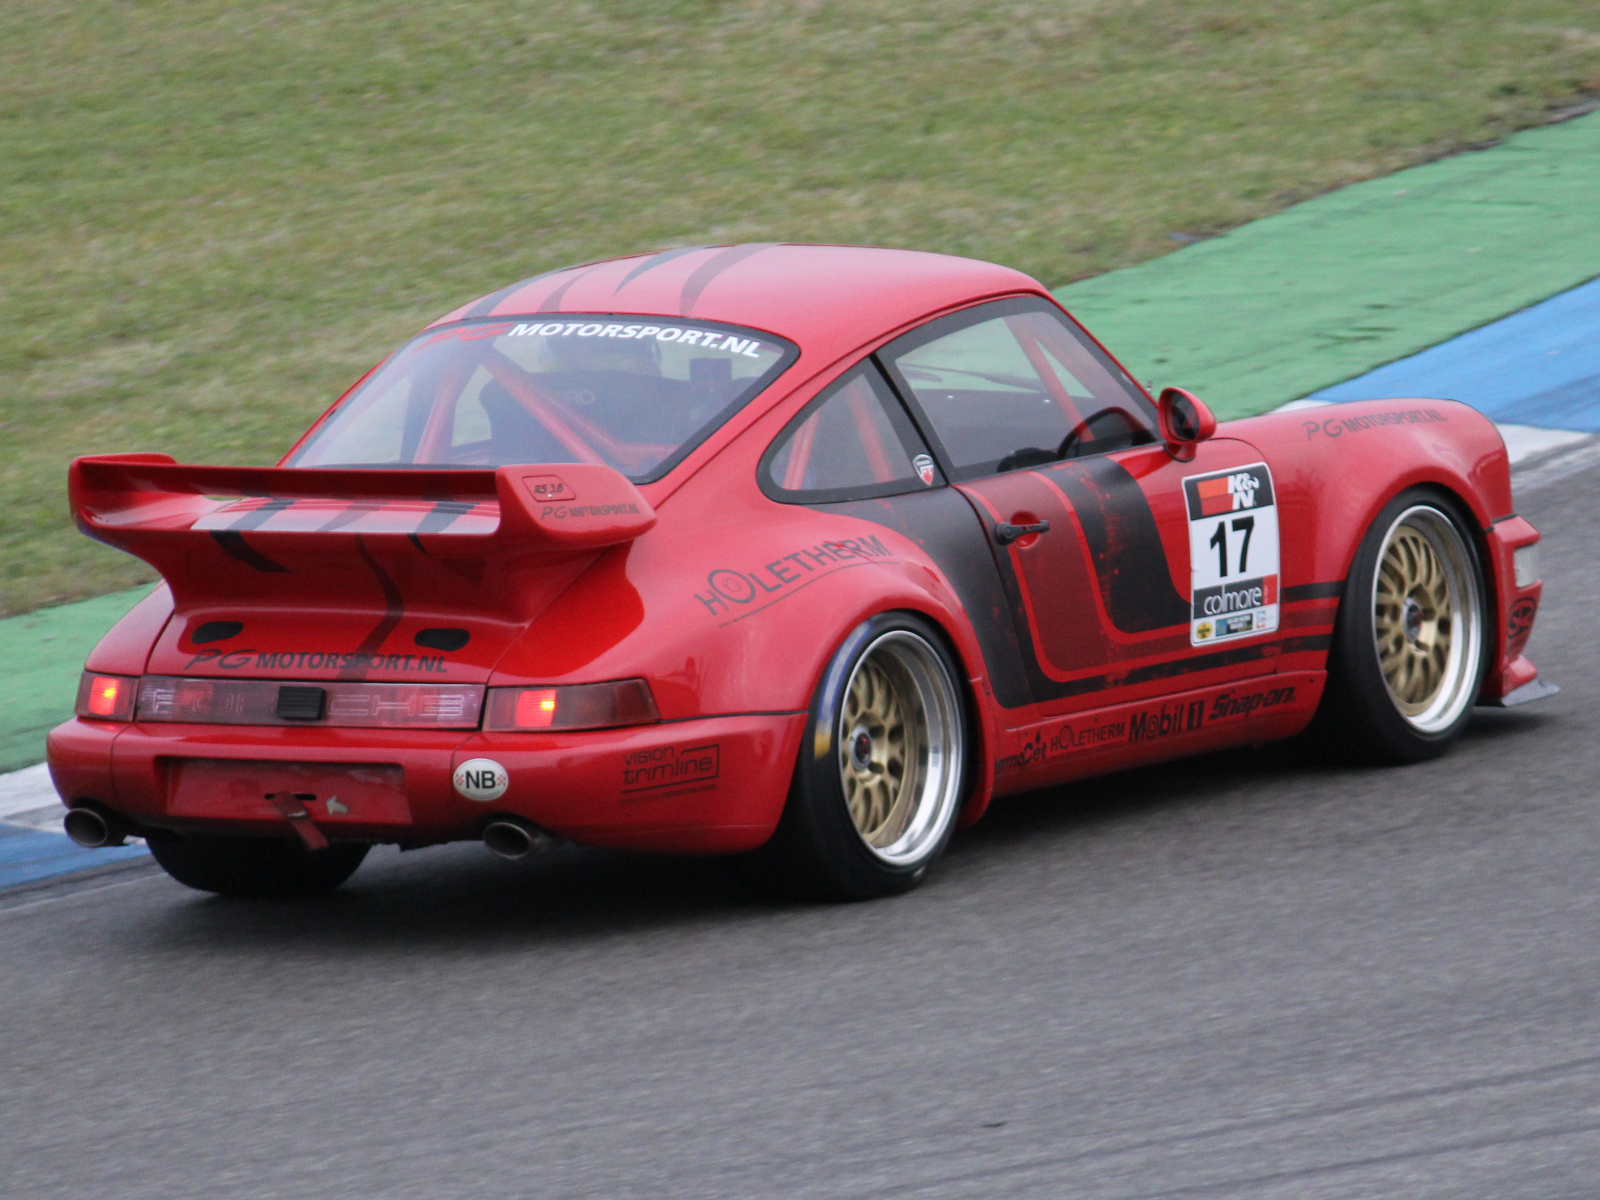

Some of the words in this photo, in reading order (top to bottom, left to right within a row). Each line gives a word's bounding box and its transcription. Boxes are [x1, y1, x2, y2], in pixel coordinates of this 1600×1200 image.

[507, 323, 760, 358] MOTORSPORT.NL
[1303, 418, 1343, 441] PG
[1342, 409, 1448, 433] MOTORSPORT.NL
[541, 506, 568, 520] PG
[568, 504, 640, 518] MOTORSPORT.NL
[1210, 515, 1255, 578] 17
[694, 535, 892, 616] HOLETHERM
[1204, 583, 1263, 616] colmore
[184, 648, 256, 670] PG
[255, 651, 448, 673] MOTORSPORT.NL
[1128, 703, 1185, 742] Mobil
[623, 746, 676, 766] vision
[623, 756, 713, 785] trimline
[465, 770, 497, 790] NB
